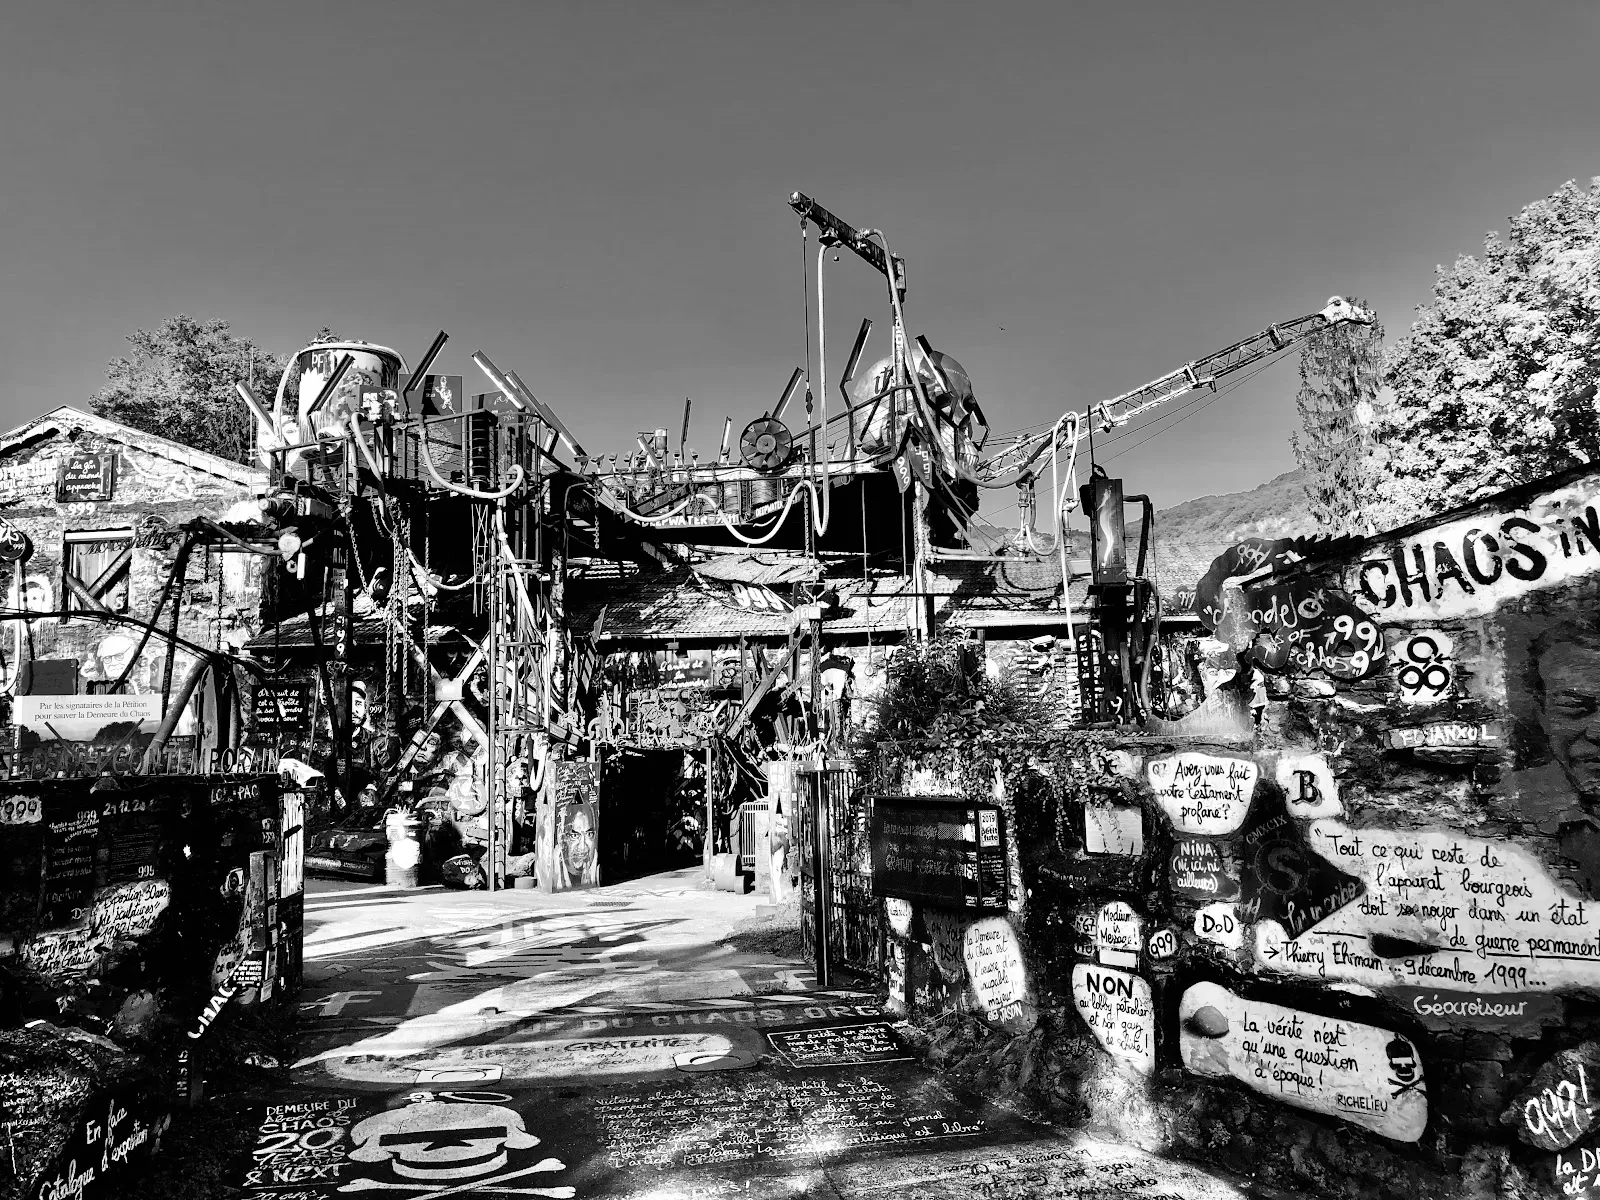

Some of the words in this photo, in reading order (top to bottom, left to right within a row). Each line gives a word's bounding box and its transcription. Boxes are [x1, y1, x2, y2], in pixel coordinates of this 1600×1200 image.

[84, 460, 96, 473] fin
[897, 456, 910, 489] 999
[68, 502, 96, 515] 999
[731, 583, 785, 611] 999
[34, 713, 52, 721] pour
[78, 711, 85, 719] la
[86, 711, 119, 719] Demeure
[119, 710, 129, 718] du
[130, 709, 151, 717] Chaos
[40, 702, 52, 710] Par
[54, 702, 64, 710] les
[65, 701, 103, 711] signataires
[104, 701, 113, 709] de
[122, 700, 148, 708] Pétition
[1226, 761, 1251, 790] fait
[1159, 783, 1185, 799] votre
[1292, 770, 1323, 807] B
[1372, 844, 1388, 858] ce
[1394, 842, 1423, 871] qui
[1480, 845, 1504, 869] de
[1460, 867, 1533, 908] bourgeois
[1103, 904, 1133, 923] Medium
[1358, 894, 1389, 917] doit
[1421, 903, 1460, 931] noyer
[1468, 898, 1507, 923] dans
[1515, 910, 1541, 923] un
[1548, 898, 1589, 926] état
[974, 928, 1002, 944] Demeure
[1112, 922, 1121, 933] is
[995, 934, 1009, 954] est
[1150, 932, 1173, 959] 999
[1450, 924, 1468, 948] de
[1475, 933, 1521, 959] guerre
[1281, 941, 1326, 978] Thierry
[1417, 955, 1478, 984] décembre
[1086, 972, 1133, 999] NON
[1000, 1001, 1023, 1025] JASON
[1091, 992, 1113, 1021] lobby
[1116, 995, 1150, 1021] pétrolier
[1413, 995, 1529, 1017] Géocroiseur
[807, 1029, 839, 1040] existe
[858, 1025, 887, 1035] autre
[1089, 1014, 1099, 1027] et
[1102, 1017, 1116, 1030] son
[1266, 1012, 1304, 1040] vérité
[1313, 1022, 1348, 1047] n'est
[787, 1039, 822, 1047] monde
[1105, 1030, 1115, 1046] de
[1241, 1036, 1288, 1062] qu'une
[1294, 1044, 1360, 1073] question
[266, 1101, 330, 1116] DEMEURE
[337, 1097, 357, 1109] DU
[826, 1094, 874, 1106] premier
[879, 1092, 896, 1101] de
[856, 1101, 896, 1111] 2016
[86, 1120, 102, 1145] En
[107, 1099, 128, 1149] face
[258, 1116, 351, 1134] CHAOS
[902, 1110, 946, 1128] journal
[252, 1126, 346, 1155] 20
[913, 1125, 935, 1137] est
[252, 1144, 346, 1166] YEARS
[993, 1159, 1012, 1170] du
[38, 1158, 96, 1200] Catalogue
[241, 1170, 263, 1187] &
[272, 1161, 353, 1182] NEXT
